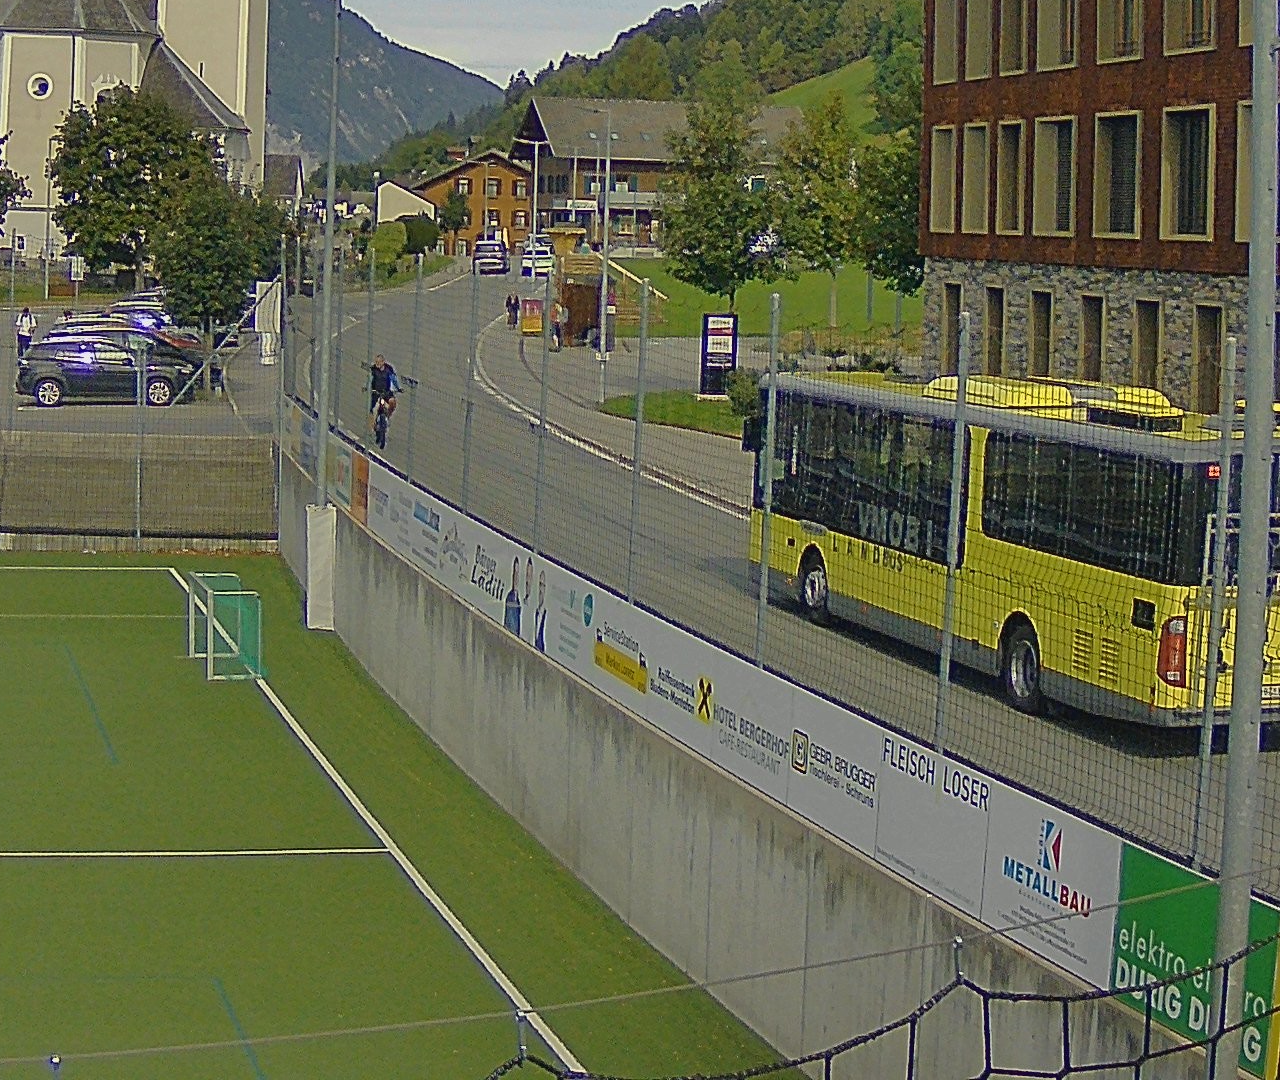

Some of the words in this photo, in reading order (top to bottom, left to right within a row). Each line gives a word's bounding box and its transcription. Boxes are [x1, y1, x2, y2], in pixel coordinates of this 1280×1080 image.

[714, 704, 737, 731] HOTEL
[740, 718, 790, 759] BERGERHOF
[883, 737, 935, 786] FLEISCH
[943, 766, 989, 812] LOSER
[1003, 856, 1092, 918] METALLBAU
[1119, 920, 1185, 975] elektro
